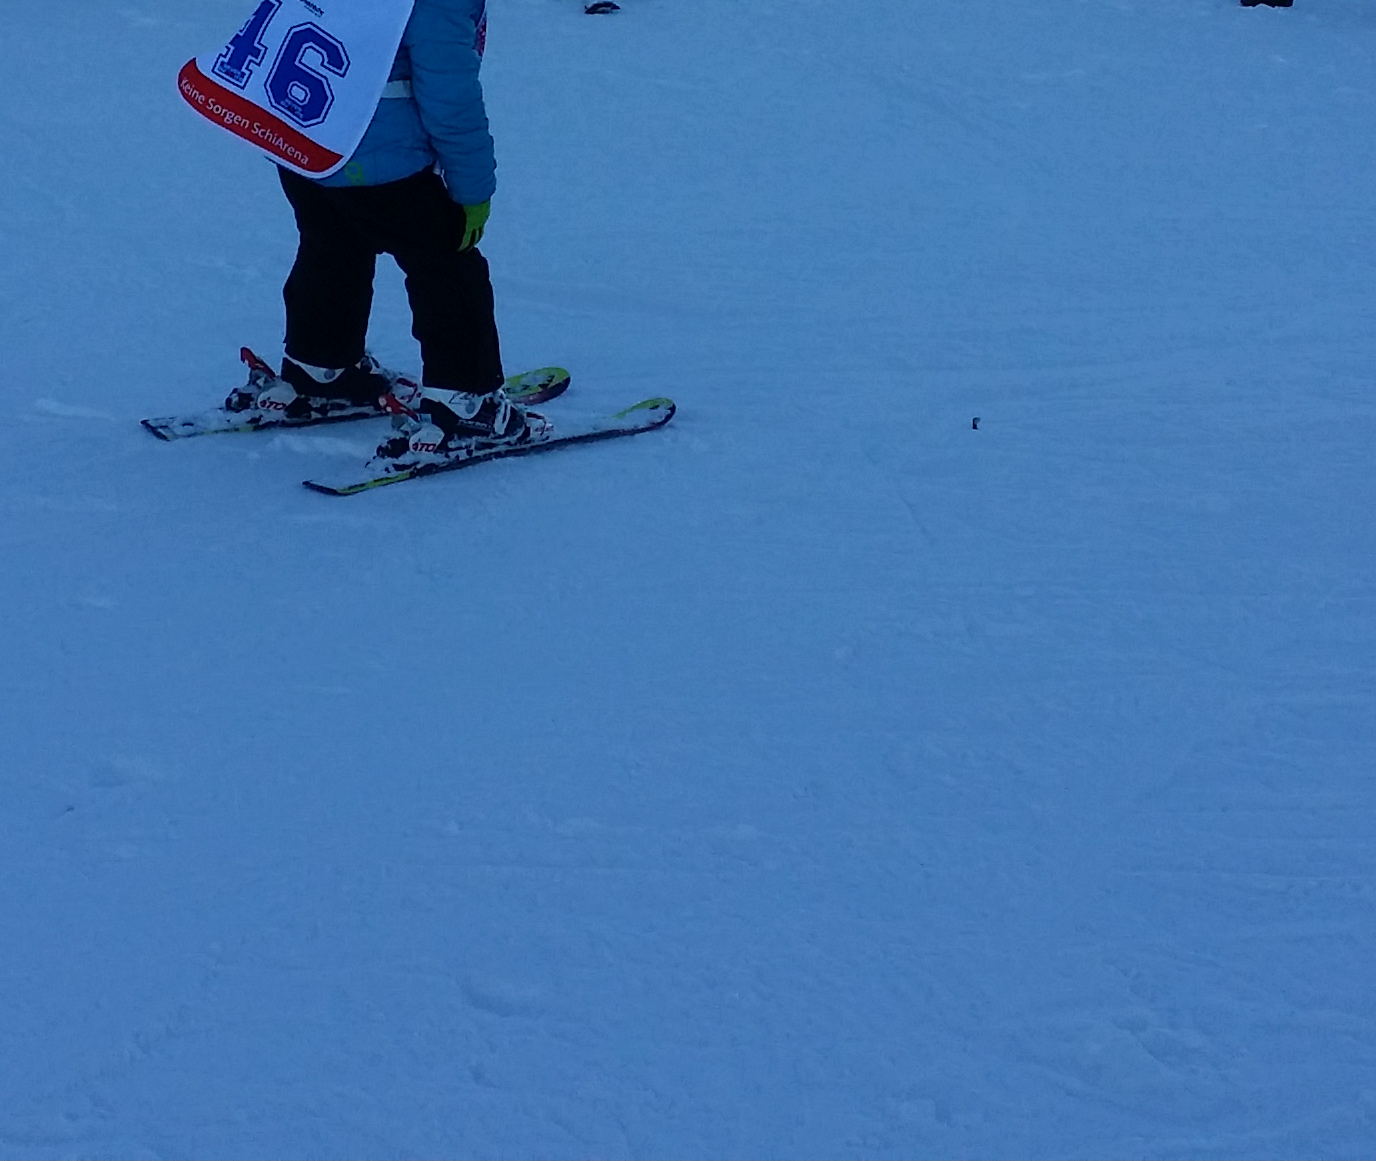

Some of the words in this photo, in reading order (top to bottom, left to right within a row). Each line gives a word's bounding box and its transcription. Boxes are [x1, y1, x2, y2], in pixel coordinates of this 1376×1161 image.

[180, 79, 205, 105] Keine
[206, 98, 250, 130] Sorgen
[251, 122, 309, 165] SchiArena
